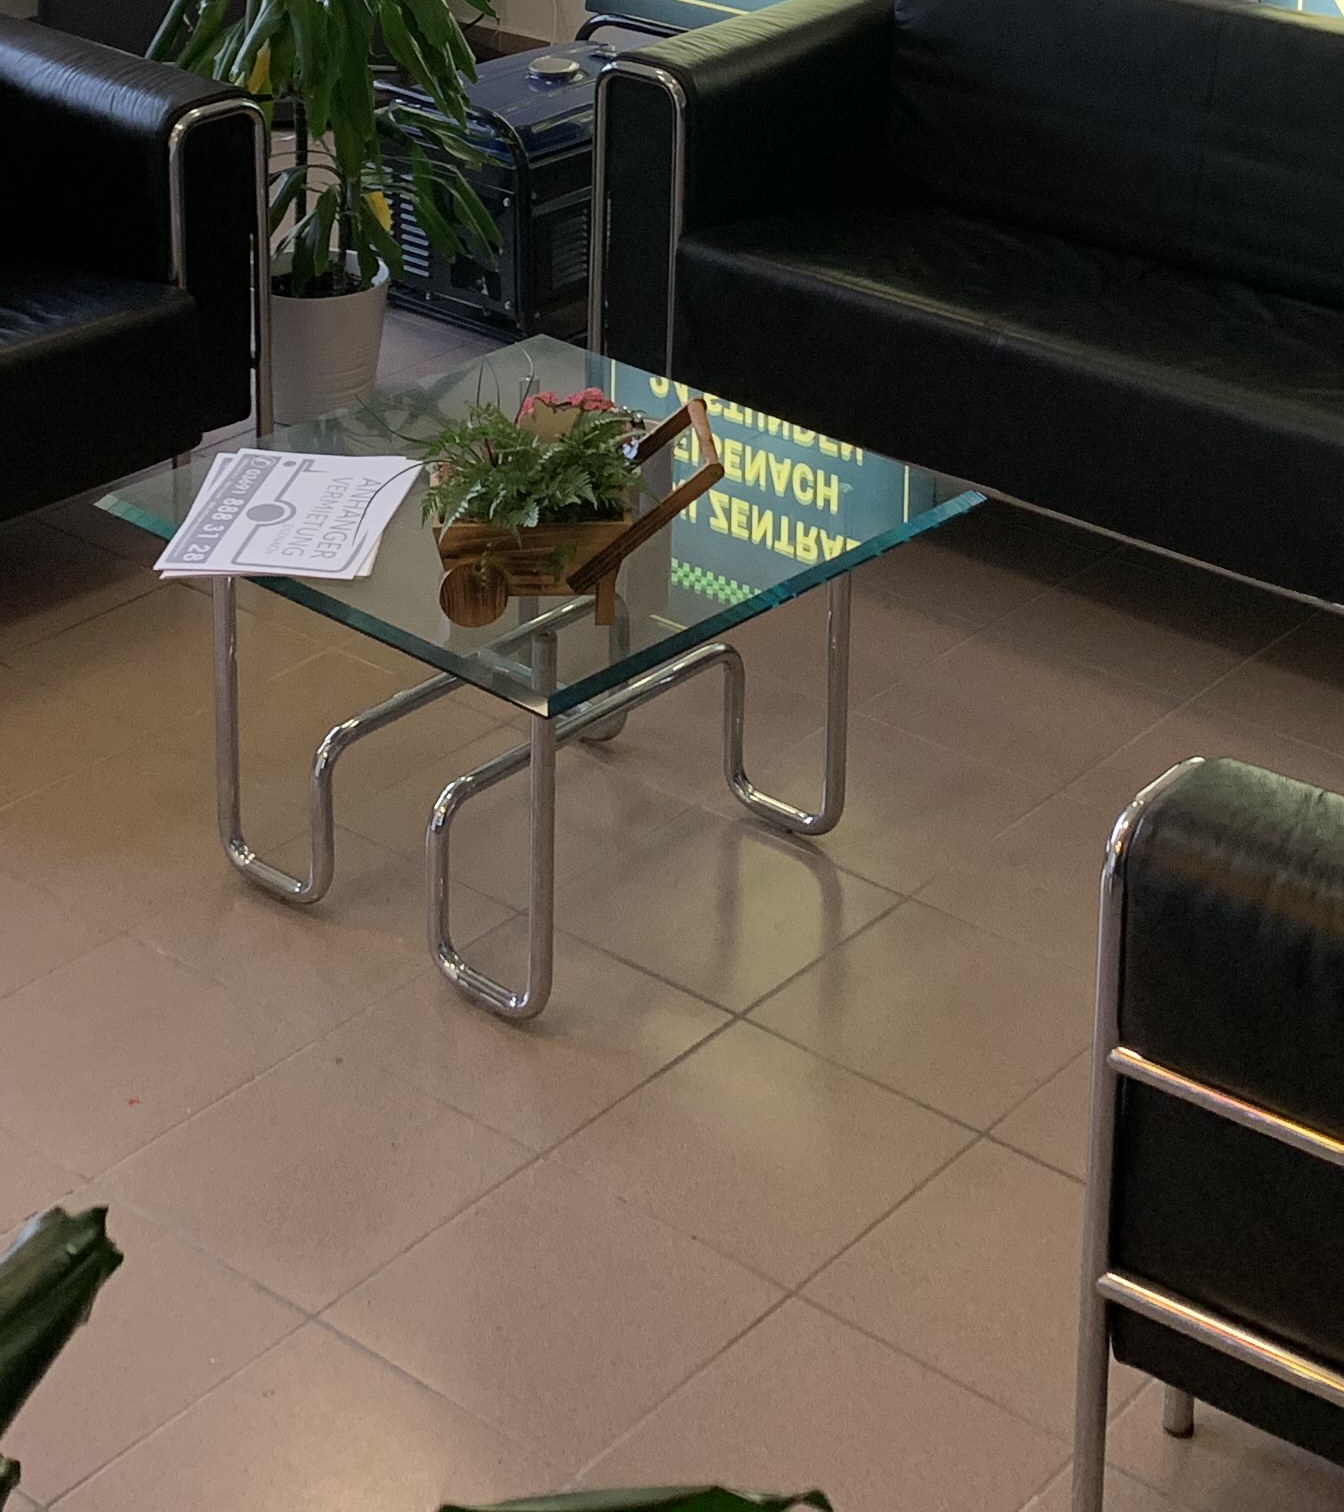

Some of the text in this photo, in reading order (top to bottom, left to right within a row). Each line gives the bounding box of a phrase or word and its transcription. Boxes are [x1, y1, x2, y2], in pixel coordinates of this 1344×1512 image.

[231, 468, 261, 496] 03691
[211, 498, 244, 522] 888
[281, 476, 355, 558] VERMIETUNG
[203, 523, 225, 539] 31
[182, 543, 211, 563] 28
